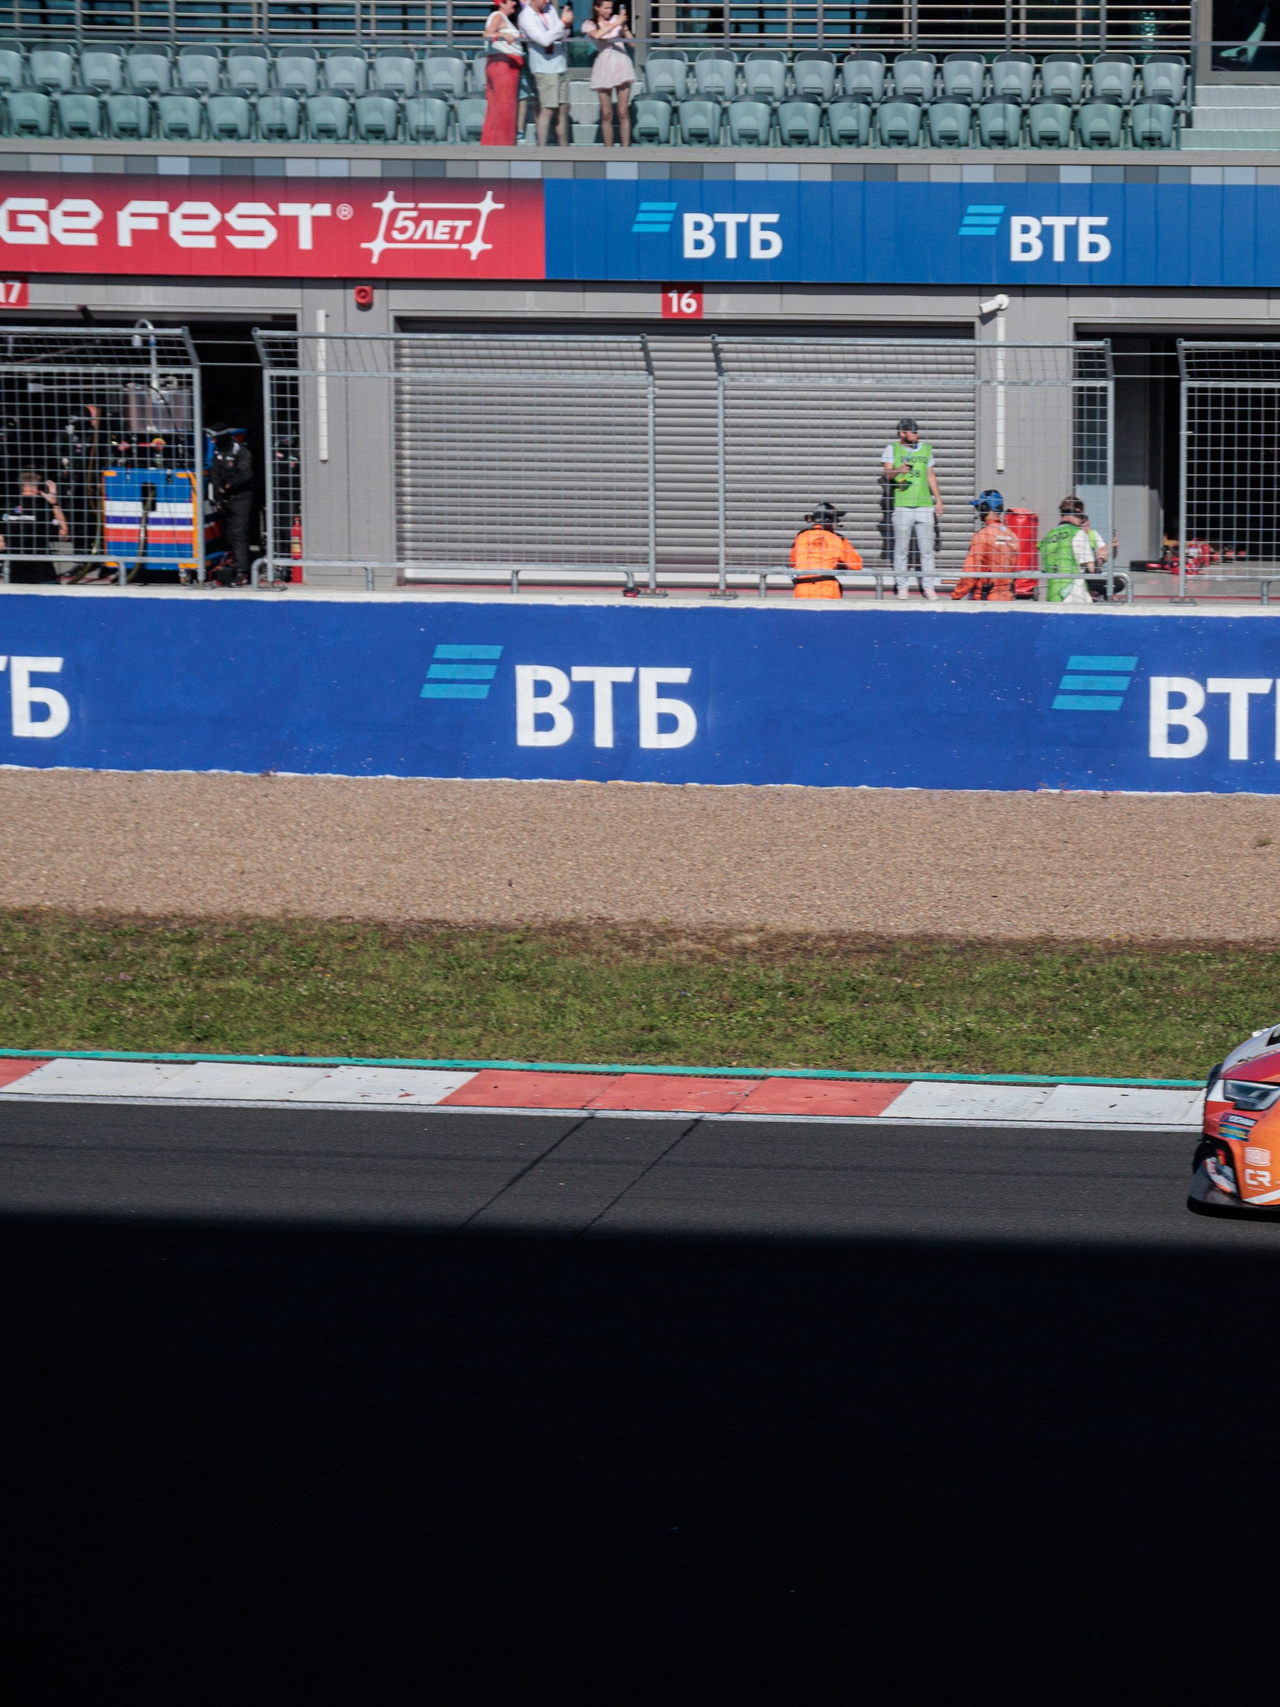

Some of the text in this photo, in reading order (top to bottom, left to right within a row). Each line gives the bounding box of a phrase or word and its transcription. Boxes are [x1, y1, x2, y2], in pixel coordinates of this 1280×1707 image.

[683, 212, 783, 259] ВТБ
[1010, 215, 1112, 262] ВТБ
[668, 292, 698, 314] 16
[515, 664, 699, 749] ВТБ
